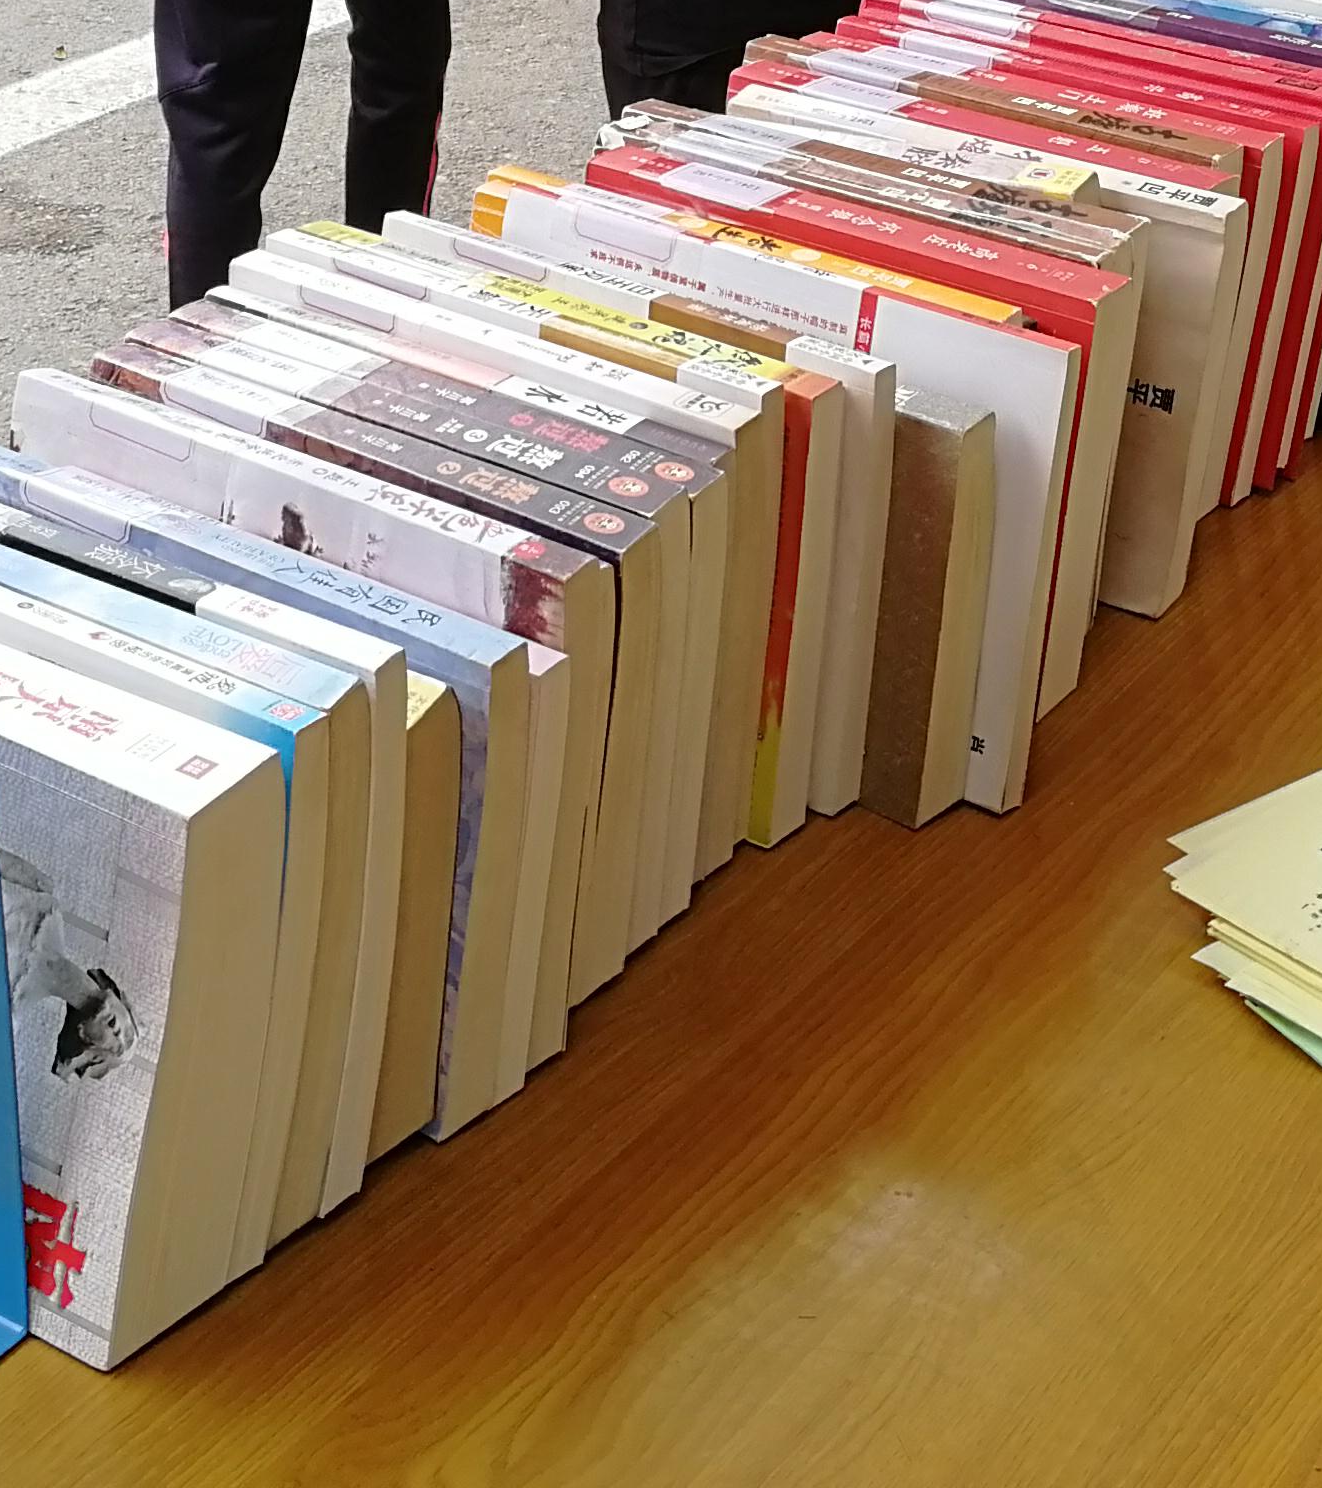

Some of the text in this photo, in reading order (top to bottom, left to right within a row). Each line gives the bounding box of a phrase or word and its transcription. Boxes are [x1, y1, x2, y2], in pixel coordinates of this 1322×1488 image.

[271, 549, 450, 640] 民国有佳人
